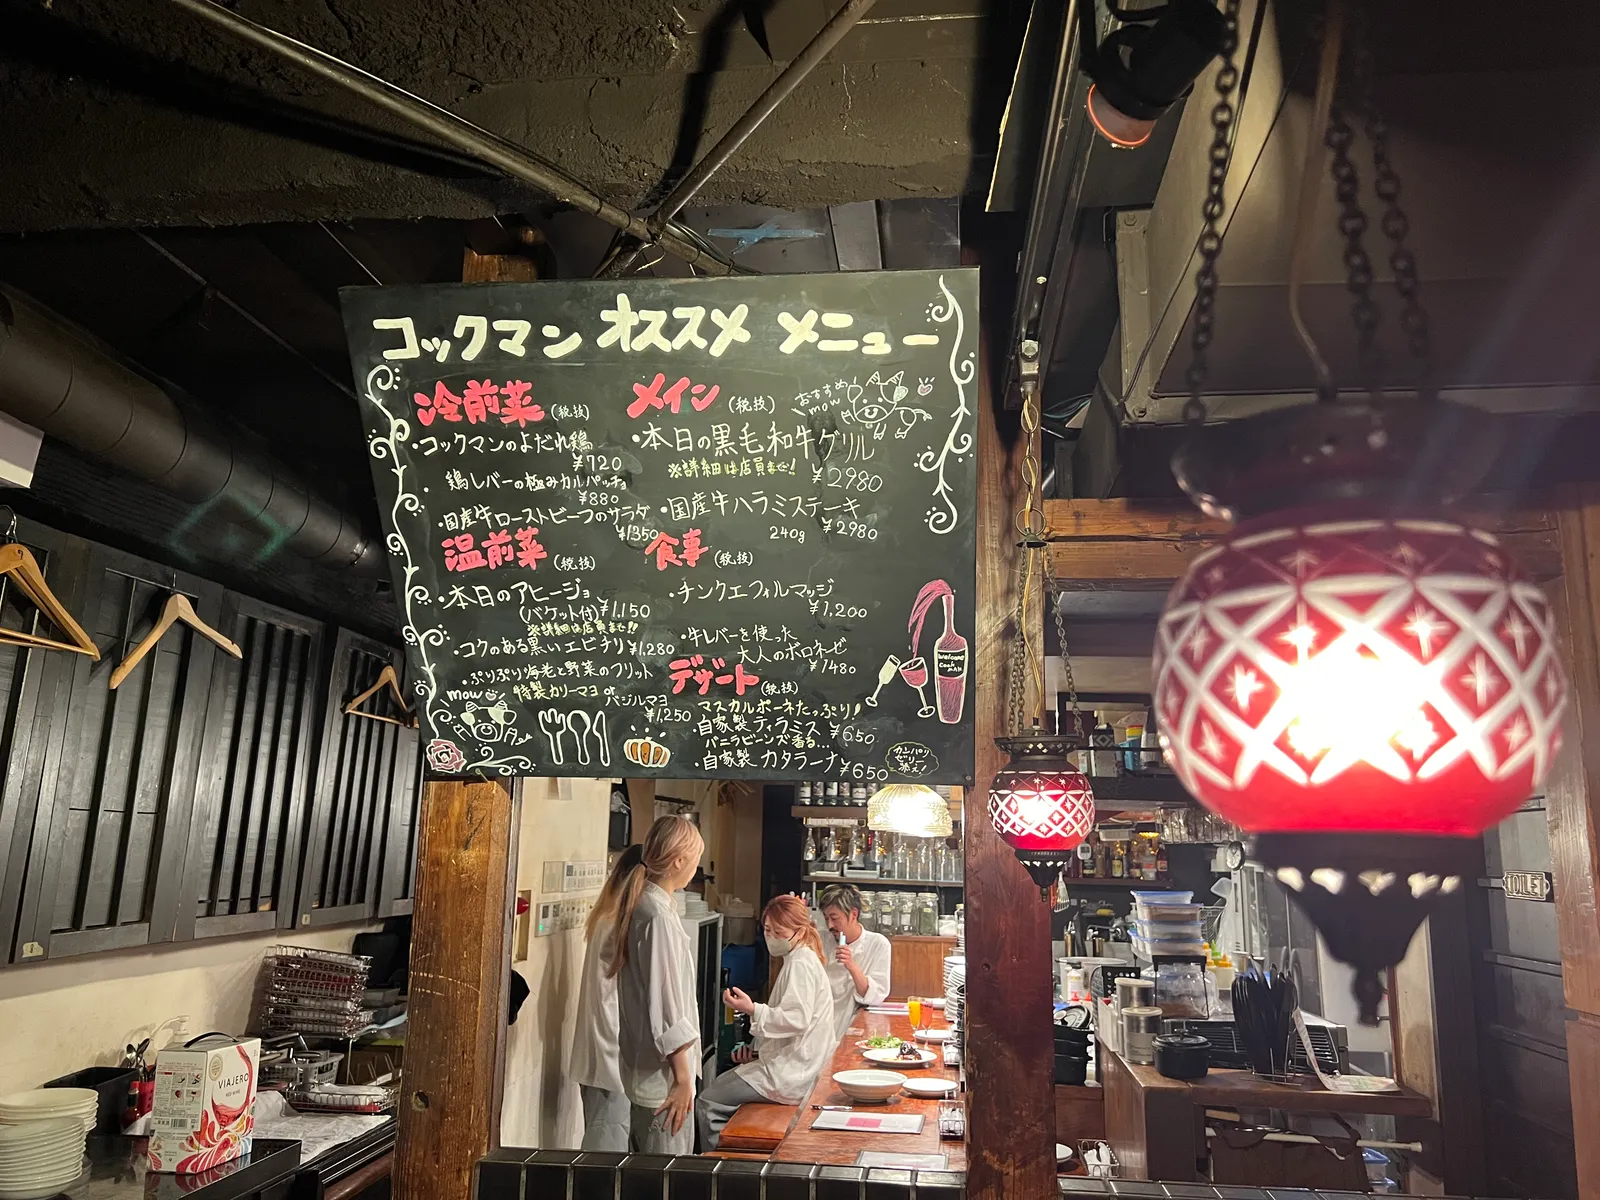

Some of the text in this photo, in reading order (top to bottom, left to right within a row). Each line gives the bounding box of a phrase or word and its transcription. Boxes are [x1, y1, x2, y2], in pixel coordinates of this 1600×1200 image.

[373, 293, 939, 362] コックマン オススメ メニュー
[414, 379, 590, 428] 冷前菜 (税抜)
[627, 373, 775, 418] メイン (税抜)
[795, 379, 848, 406] おすすめ
[572, 453, 622, 471] ¥720
[811, 463, 883, 493] ¥2980
[578, 489, 619, 506] ¥880
[769, 517, 878, 543] 240g ¥2980
[441, 526, 596, 572] 温前菜 (税抜)
[645, 528, 753, 571] 食事 (税抜)
[809, 599, 868, 618] ¥1,200
[627, 639, 675, 656] ¥1,280
[669, 653, 760, 695] デザート
[446, 690, 483, 701] mow
[830, 721, 876, 745] ¥650
[840, 760, 889, 781] ¥650
[218, 1073, 249, 1089] VIAJERO
